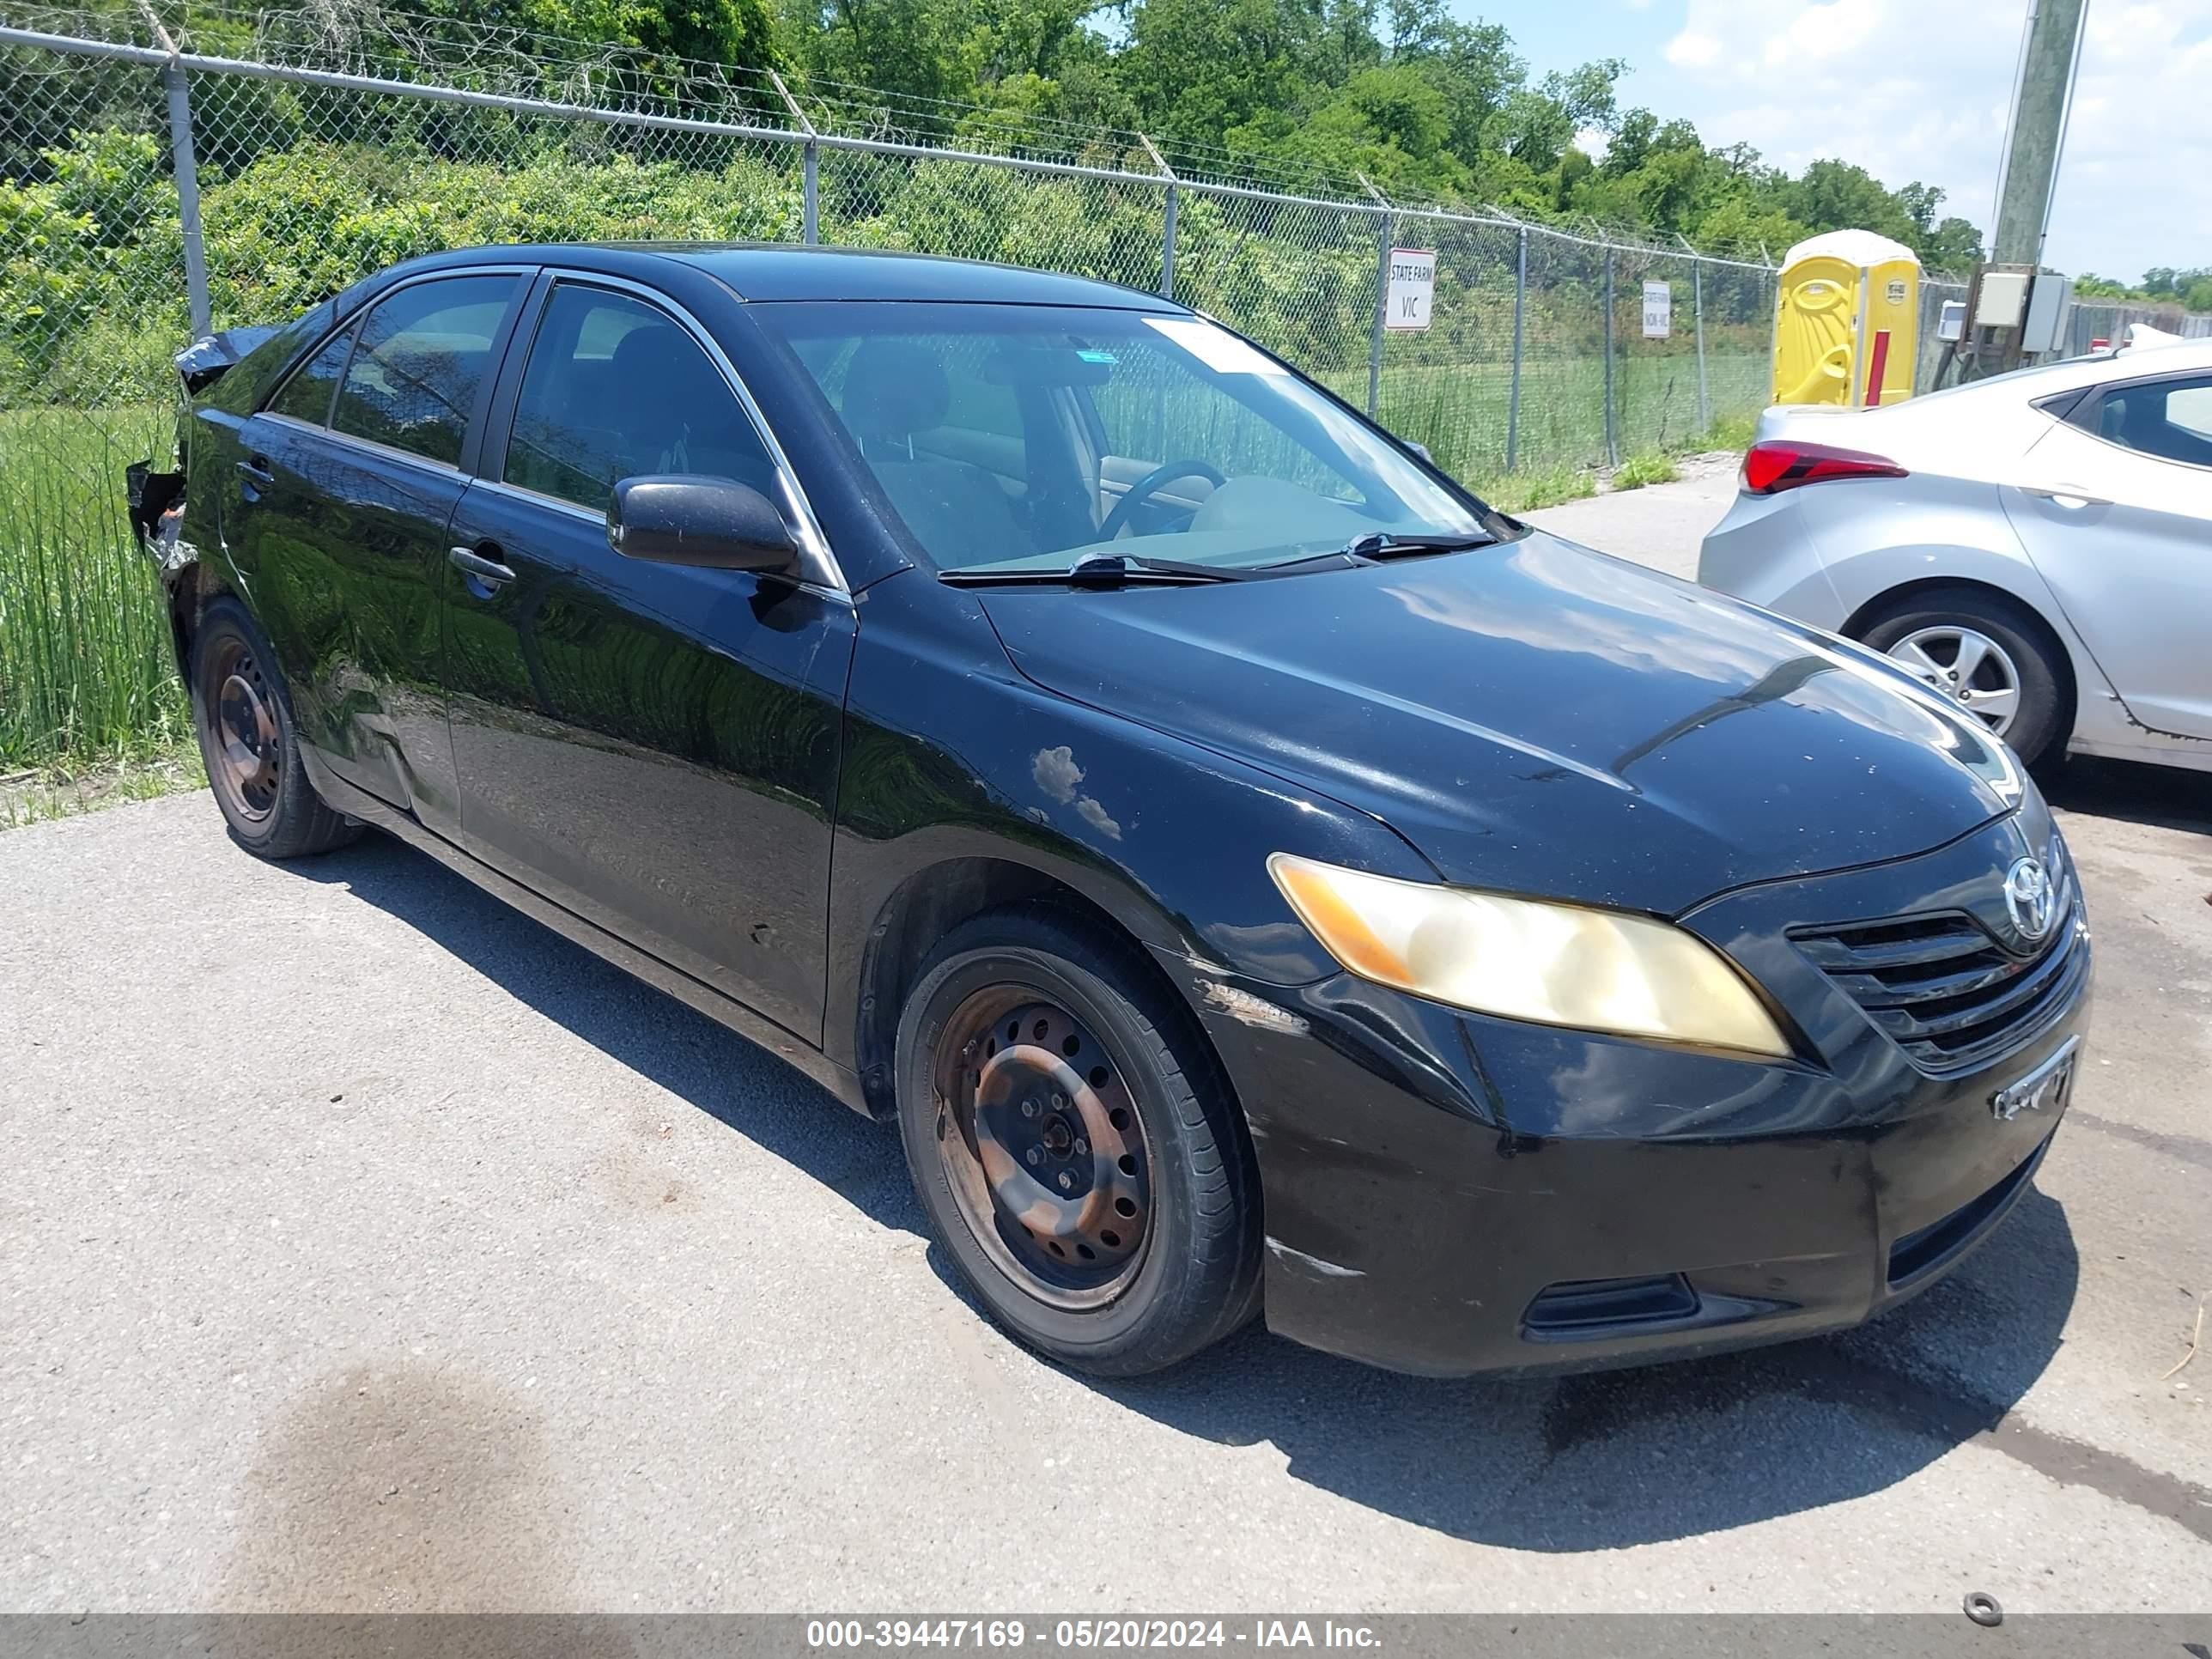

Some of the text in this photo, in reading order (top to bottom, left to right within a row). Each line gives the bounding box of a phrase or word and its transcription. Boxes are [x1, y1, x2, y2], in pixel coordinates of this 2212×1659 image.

[1391, 264, 1433, 282] STATE FARM
[1402, 296, 1419, 318] VIC
